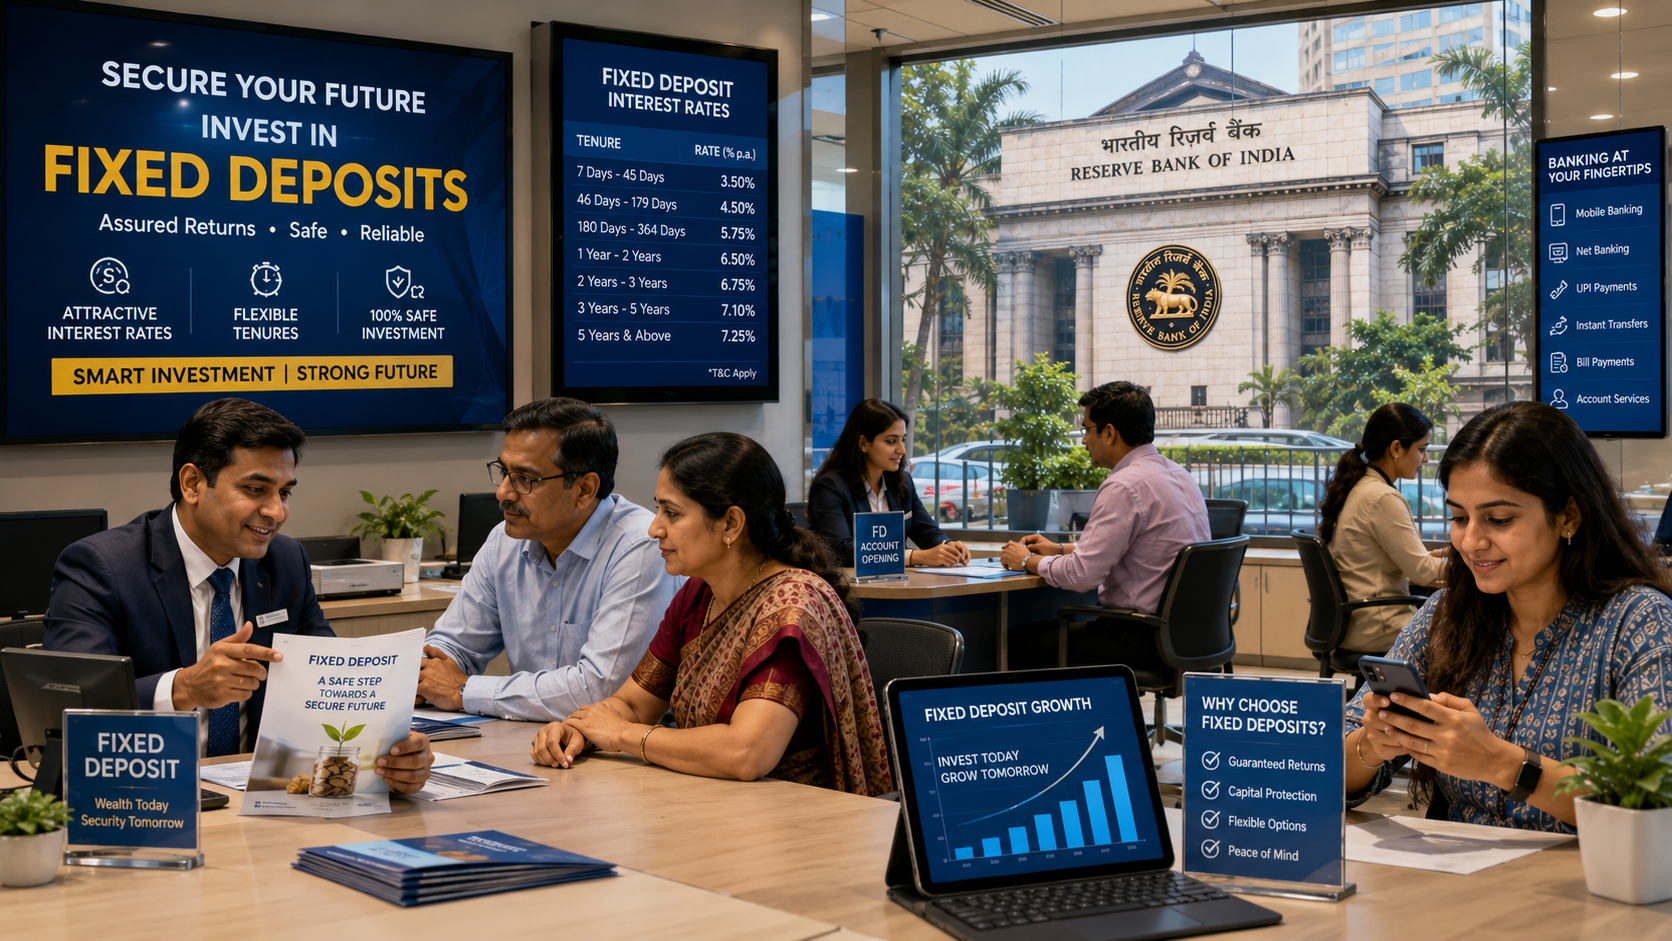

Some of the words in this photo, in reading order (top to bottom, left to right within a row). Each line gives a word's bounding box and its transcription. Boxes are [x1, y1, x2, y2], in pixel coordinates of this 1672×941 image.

[101, 61, 227, 97] SECURE
[235, 74, 317, 105] YOUR
[325, 83, 426, 114] FUTURE
[602, 67, 655, 90] FIXED
[659, 73, 734, 98] DEPOSIT
[608, 92, 681, 114] INTEREST
[685, 99, 730, 118] RATES
[201, 114, 302, 145] INVEST
[310, 124, 337, 147] IN
[1226, 119, 1262, 139] बैंक
[577, 134, 621, 149] TENURE
[695, 145, 720, 158] RATE
[722, 147, 735, 160] (%
[737, 149, 756, 161] p.a.)
[1548, 153, 1609, 169] BANKING
[1612, 150, 1629, 163] AT
[1071, 161, 1143, 181] RESERVE
[1152, 156, 1200, 173] BANK
[1208, 153, 1232, 167] OF
[1240, 147, 1295, 165] INDIA
[44, 144, 210, 198] FIXED
[229, 155, 469, 212] DEPOSITS
[577, 165, 584, 177] 7
[587, 167, 613, 181] Days
[623, 169, 637, 181] 45
[639, 169, 665, 184] Days
[1548, 171, 1580, 183] YOUR
[1584, 163, 1652, 180] FINGERTIPS
[721, 175, 755, 190] 3.50%
[577, 193, 592, 206] 46
[594, 195, 621, 209] Days
[632, 197, 649, 209] 179
[652, 198, 677, 212] Days
[720, 201, 755, 215] 4.50%
[1576, 207, 1606, 218] Mobile
[1608, 205, 1643, 217] Banking
[98, 213, 178, 235] Assured
[184, 217, 256, 237] Returns
[289, 222, 328, 239] Safe
[360, 225, 425, 243] Reliable
[578, 221, 597, 233] 180
[600, 222, 627, 236] Days
[637, 224, 657, 236] 364
[660, 225, 686, 239] Days
[721, 227, 755, 241] 5.75%
[578, 249, 583, 260] 1
[587, 249, 611, 261] Year
[622, 250, 629, 262] 2
[632, 250, 662, 263] Years
[1576, 246, 1591, 256] Net
[1594, 244, 1629, 257] Banking
[721, 253, 755, 266] 6.50%
[577, 275, 584, 287] 2
[587, 276, 618, 288] Years
[629, 277, 635, 289] 3
[638, 277, 668, 289] Years
[721, 279, 755, 292] 6.75%
[1576, 283, 1591, 293] UPI
[1594, 281, 1637, 294] Payments
[62, 306, 158, 321] ATTRACTIVE
[234, 308, 298, 322] FLEXIBLE
[370, 309, 402, 323] 100%
[406, 310, 437, 322] SAFE
[578, 302, 585, 314] 3
[588, 302, 619, 314] Years
[629, 303, 636, 315] 5
[638, 303, 670, 315] Years
[721, 304, 755, 317] 7.10%
[1576, 320, 1606, 330] Instant
[1608, 319, 1648, 329] Transfers
[47, 326, 122, 340] INTEREST
[125, 327, 172, 341] RATES
[233, 327, 299, 340] TENURES
[362, 327, 445, 340] INVESTMENT
[578, 329, 585, 341] 5
[588, 330, 620, 341] Years
[623, 330, 632, 341] &
[635, 330, 671, 341] Above
[721, 330, 756, 343] 7.25%
[1577, 357, 1590, 367] Bill
[1592, 356, 1634, 368] Payments
[73, 367, 145, 385] SMART
[151, 365, 276, 384] INVESTMENT
[297, 365, 370, 382] STRONG
[375, 364, 438, 380] FUTURE
[733, 368, 757, 380] Apply
[1576, 394, 1612, 404] Account
[1614, 394, 1650, 404] Services
[872, 525, 887, 538] FD
[861, 541, 899, 551] ACCOUNT
[861, 553, 899, 564] OPENING
[309, 655, 345, 666] FIXED
[348, 654, 398, 667] DEPOSIT
[317, 676, 326, 685] A
[328, 677, 355, 686] SAFE
[357, 677, 382, 686] STEP
[319, 689, 367, 698] TOWARDS
[369, 690, 376, 698] A
[305, 701, 345, 711] SECURE
[347, 701, 386, 711] FUTURE
[925, 707, 966, 722] FIXED
[969, 702, 1028, 719] DEPOSIT
[1031, 697, 1092, 713] GROWTH
[1202, 696, 1235, 711] WHY
[1238, 698, 1298, 714] CHOOSE
[1202, 716, 1243, 731] FIXED
[1247, 718, 1326, 736] DEPOSITS?
[98, 732, 164, 753] FIXED
[937, 754, 979, 768] INVEST
[981, 750, 1019, 763] TODAY
[1228, 756, 1285, 770] Guaranteed
[1288, 760, 1326, 772] Returns
[85, 757, 180, 779] DEPOSIT
[940, 770, 978, 784] GROW
[980, 764, 1049, 780] TOMORROW
[1228, 786, 1263, 799] Capital
[1265, 788, 1317, 802] Protection
[95, 798, 133, 810] Wealth
[136, 799, 169, 814] Today
[81, 814, 126, 830] Security
[128, 816, 184, 829] Tomorrow
[1229, 815, 1265, 829] Flexible
[1268, 819, 1307, 832] Options
[1229, 845, 1258, 858] Peace
[1261, 848, 1271, 859] of
[1273, 848, 1299, 861] Mind
